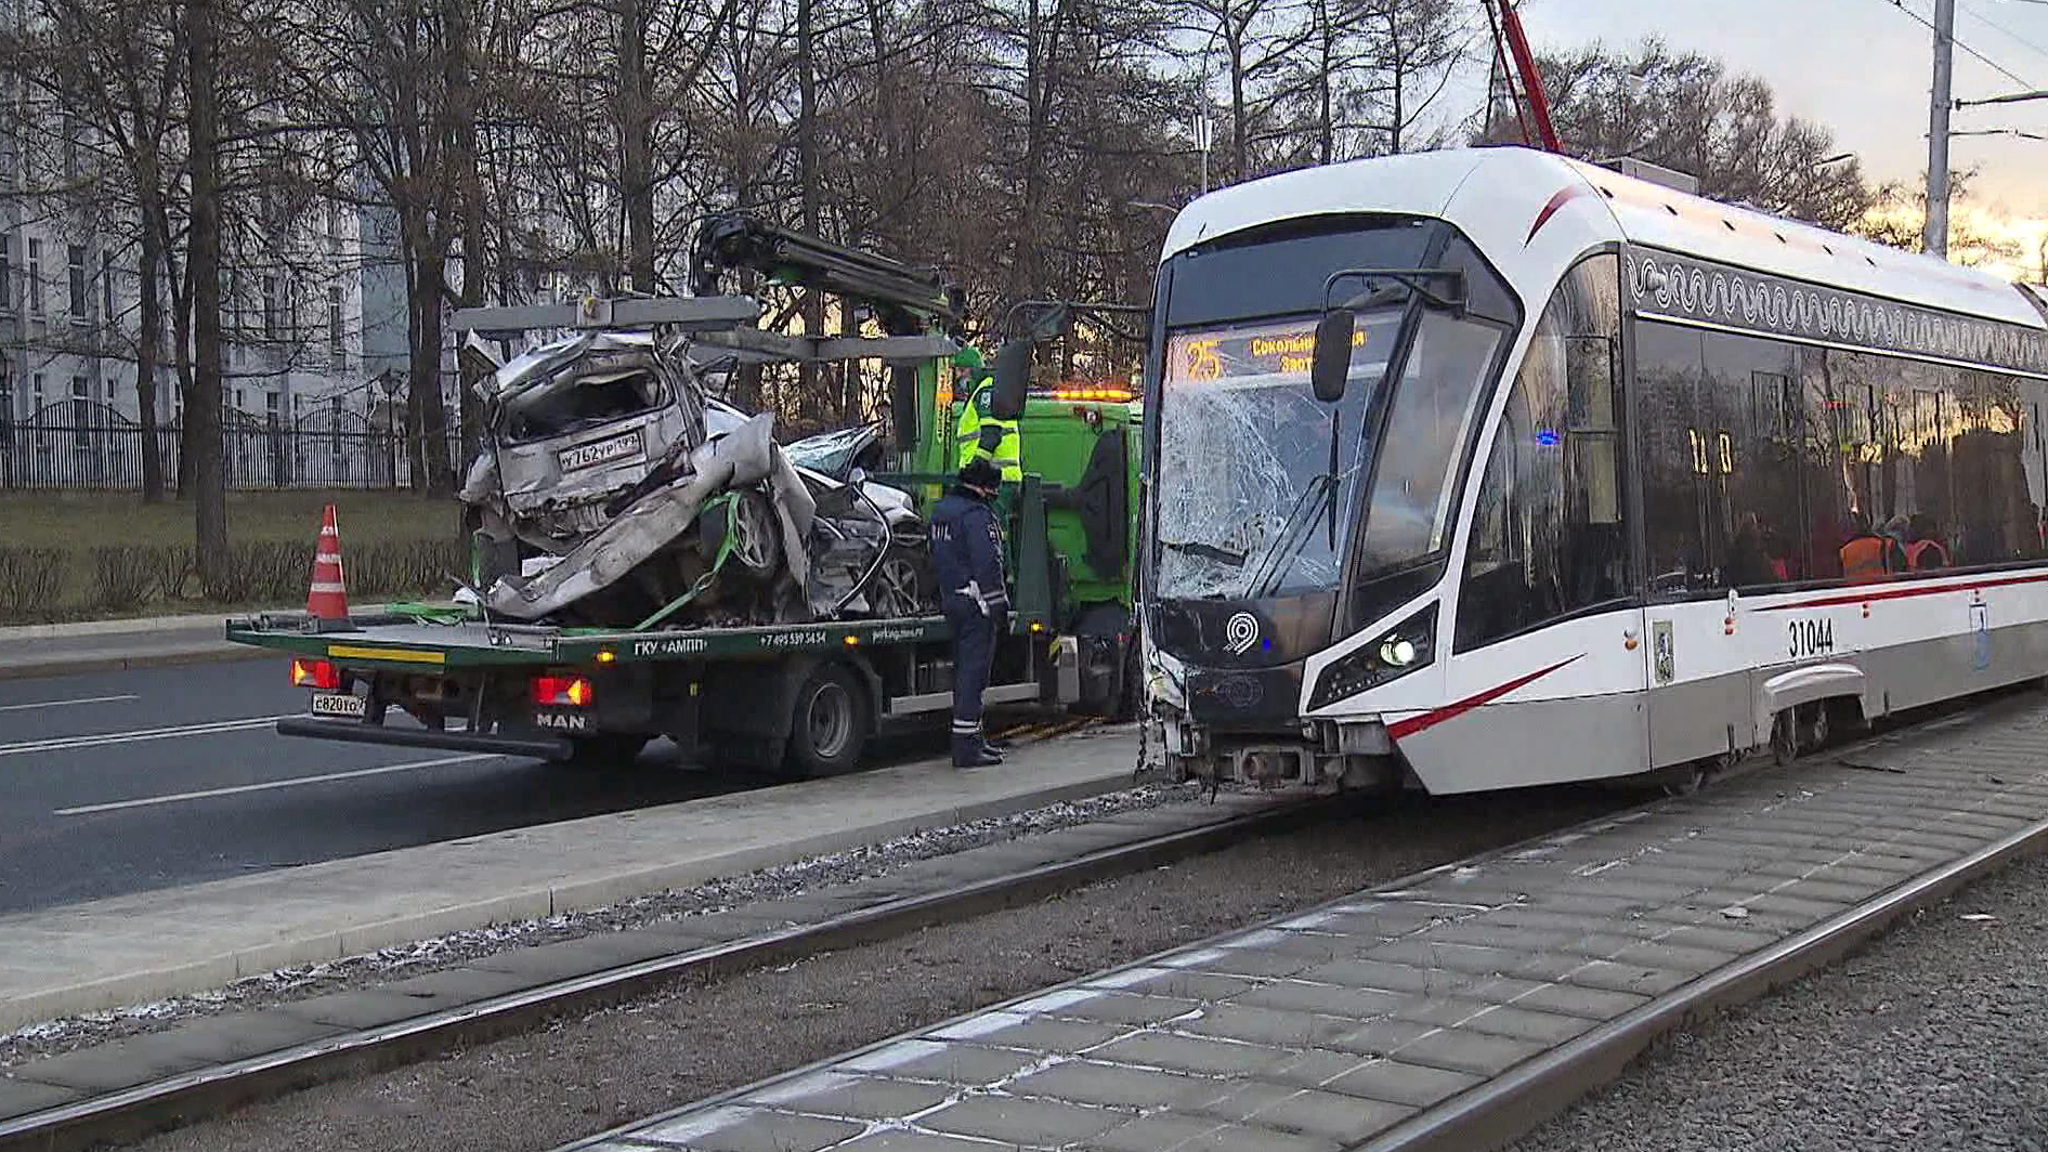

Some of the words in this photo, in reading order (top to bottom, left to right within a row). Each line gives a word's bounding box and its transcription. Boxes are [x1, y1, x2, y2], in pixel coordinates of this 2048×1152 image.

[1187, 339, 1221, 379] 25
[635, 639, 657, 656] ГКУ
[1789, 618, 1833, 657] 31044
[537, 713, 586, 729] MAN
